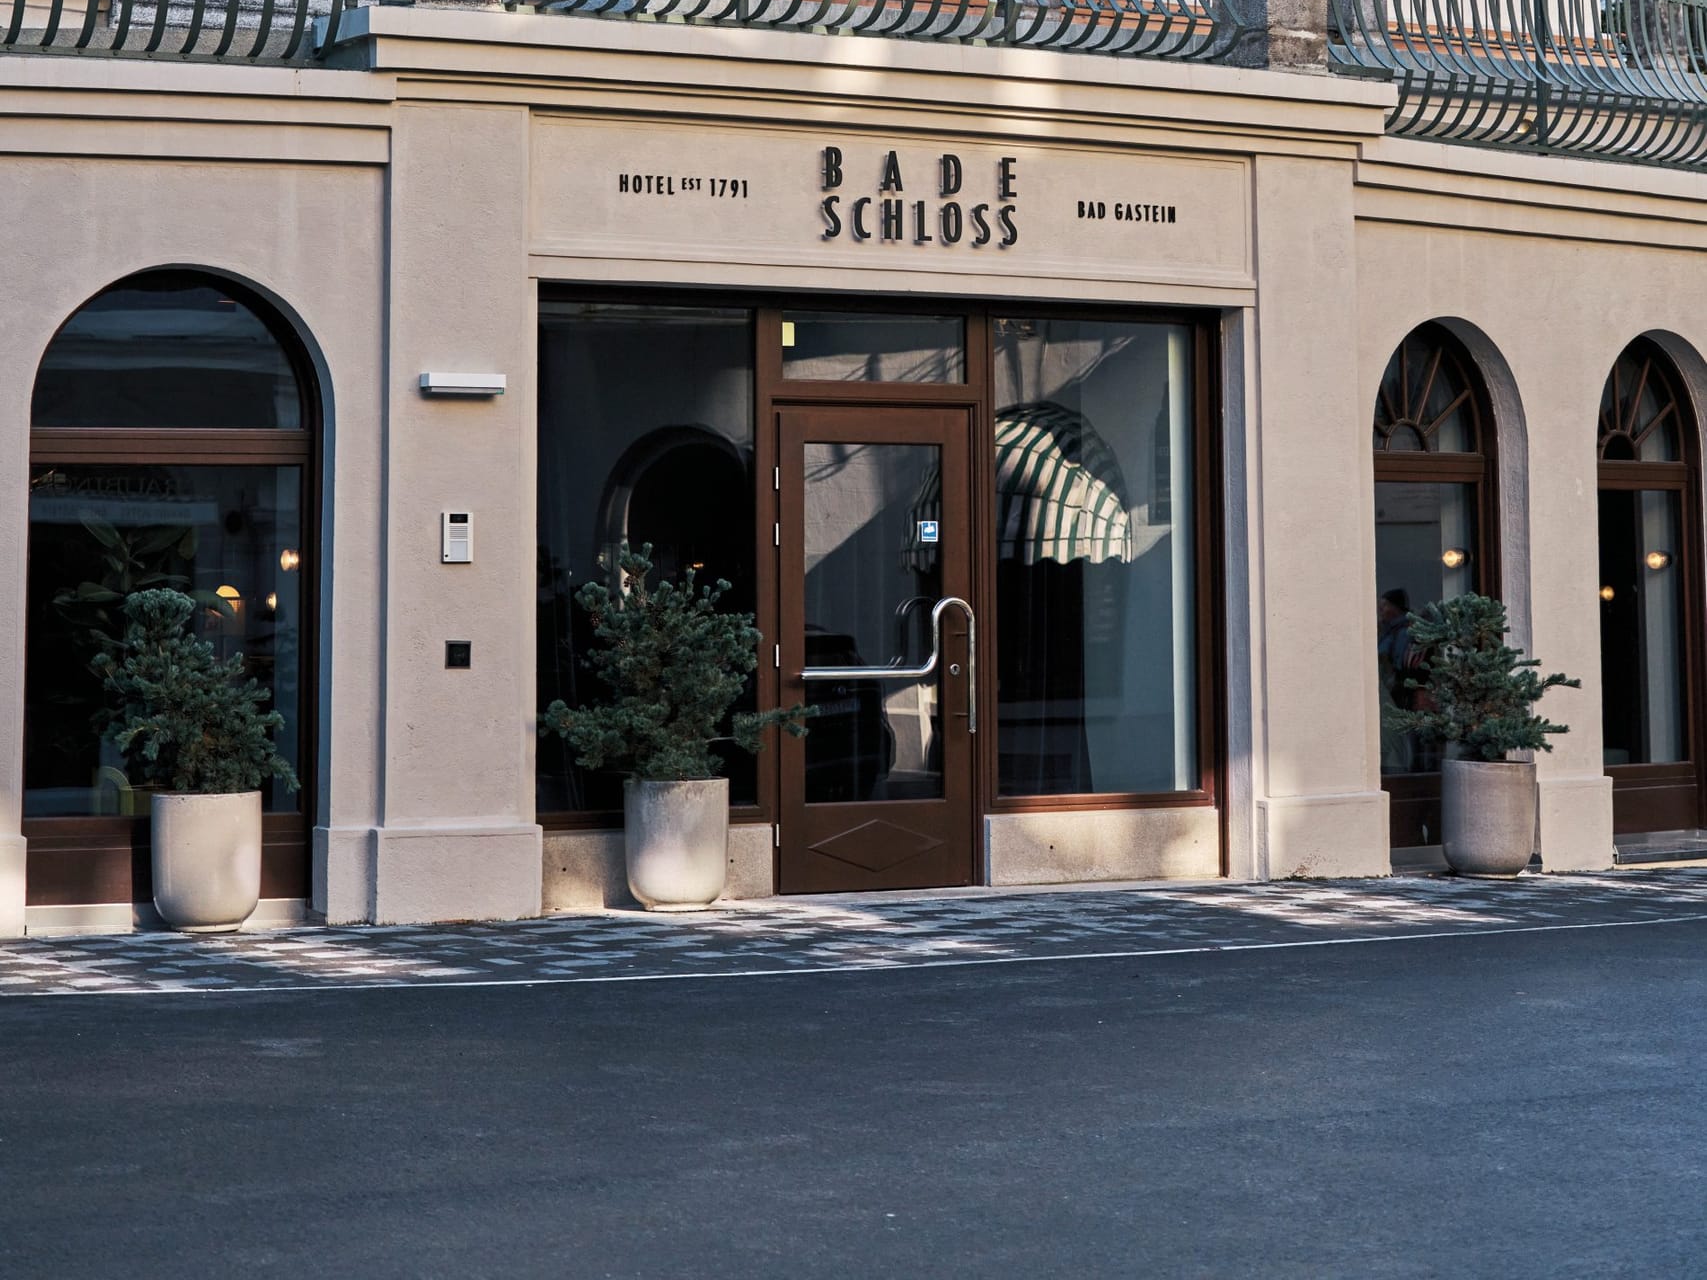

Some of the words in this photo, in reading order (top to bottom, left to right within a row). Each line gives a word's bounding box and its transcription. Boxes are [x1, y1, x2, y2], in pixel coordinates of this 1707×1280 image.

[619, 173, 675, 195] HOTEL
[681, 177, 702, 191] EST
[709, 178, 748, 198] 1791
[822, 146, 1017, 198] BADE
[822, 195, 1018, 246] SCHLOSS
[1077, 200, 1106, 219] BAD
[1114, 203, 1176, 223] GASTEIN
